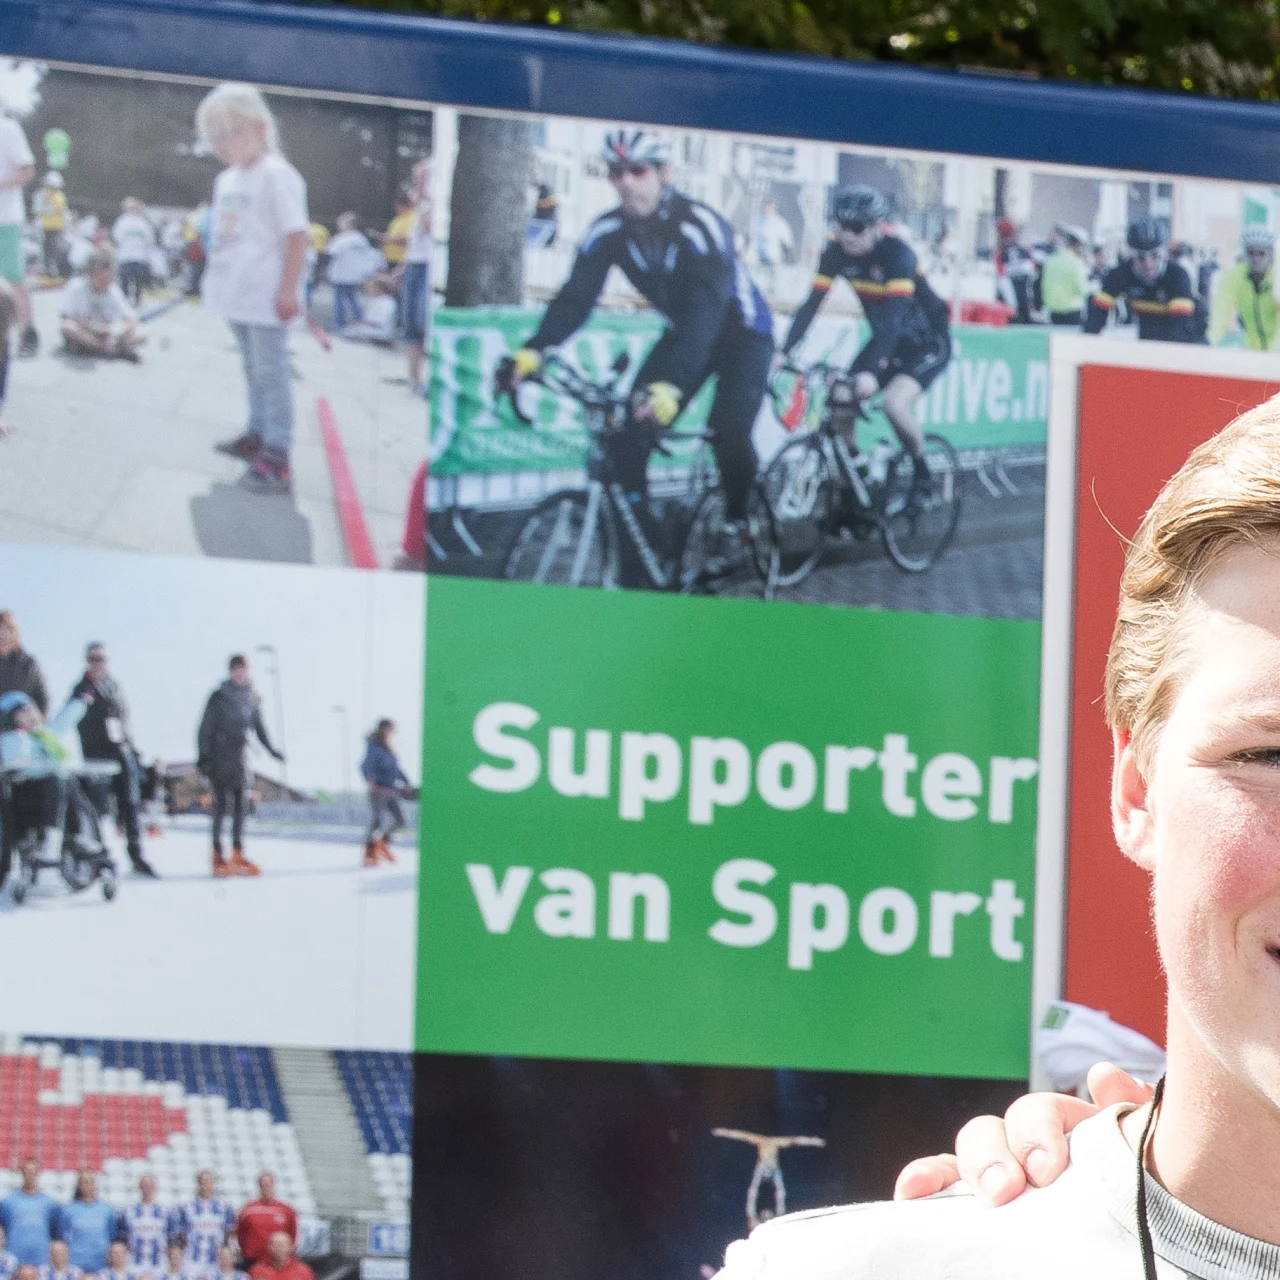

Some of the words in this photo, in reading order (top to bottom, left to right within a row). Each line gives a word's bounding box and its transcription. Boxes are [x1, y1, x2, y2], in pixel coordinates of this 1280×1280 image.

[468, 701, 1040, 825] Supporter
[464, 863, 671, 943] van
[707, 858, 1026, 970] Sport
